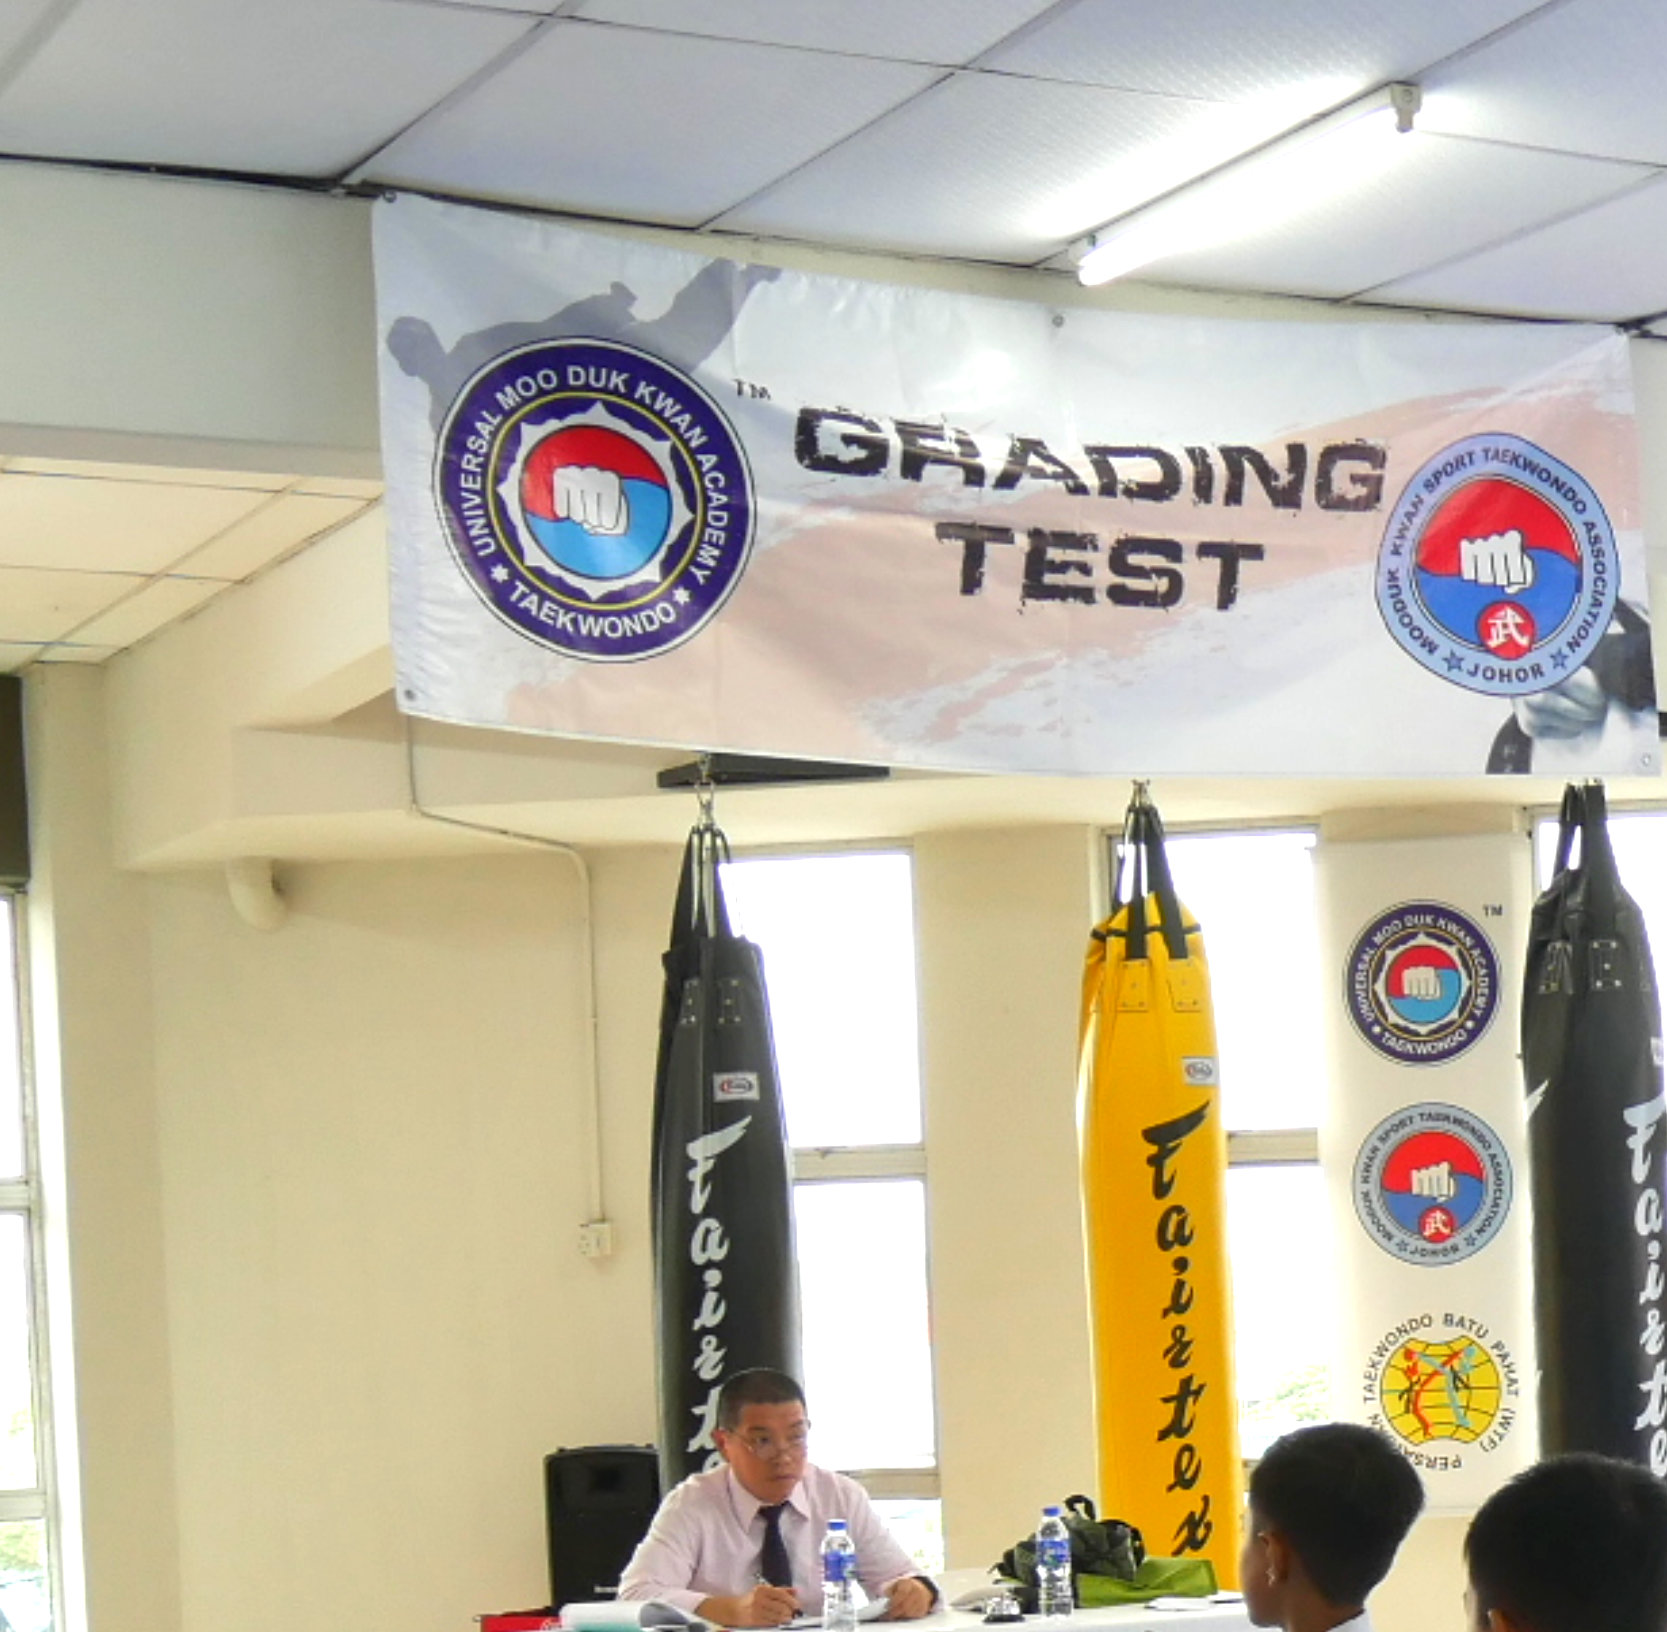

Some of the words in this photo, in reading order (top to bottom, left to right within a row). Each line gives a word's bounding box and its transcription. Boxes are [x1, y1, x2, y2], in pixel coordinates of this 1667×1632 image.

[460, 408, 503, 557] UNIVERSAL
[494, 369, 558, 410] MOO
[567, 365, 630, 393] DUK
[634, 380, 707, 448] KWAN
[690, 452, 730, 585] ACADEMY
[795, 405, 1387, 512] GRADING
[1422, 450, 1477, 493] SPORT
[1482, 447, 1586, 514] TAEKWONDO
[934, 521, 1264, 611] TEST
[1391, 493, 1424, 556] KWAN
[506, 581, 677, 638] TAEKWONDO
[1387, 567, 1440, 655] MOODUK
[1487, 605, 1529, 649] 武
[1567, 520, 1607, 653] ASSOCIATION
[1466, 662, 1545, 683] JOHOR
[686, 1115, 752, 1473] Fairt
[1141, 1100, 1214, 1556] Fairtex
[1363, 1313, 1433, 1404] TAEKWONDO
[1443, 1313, 1489, 1339] BATU
